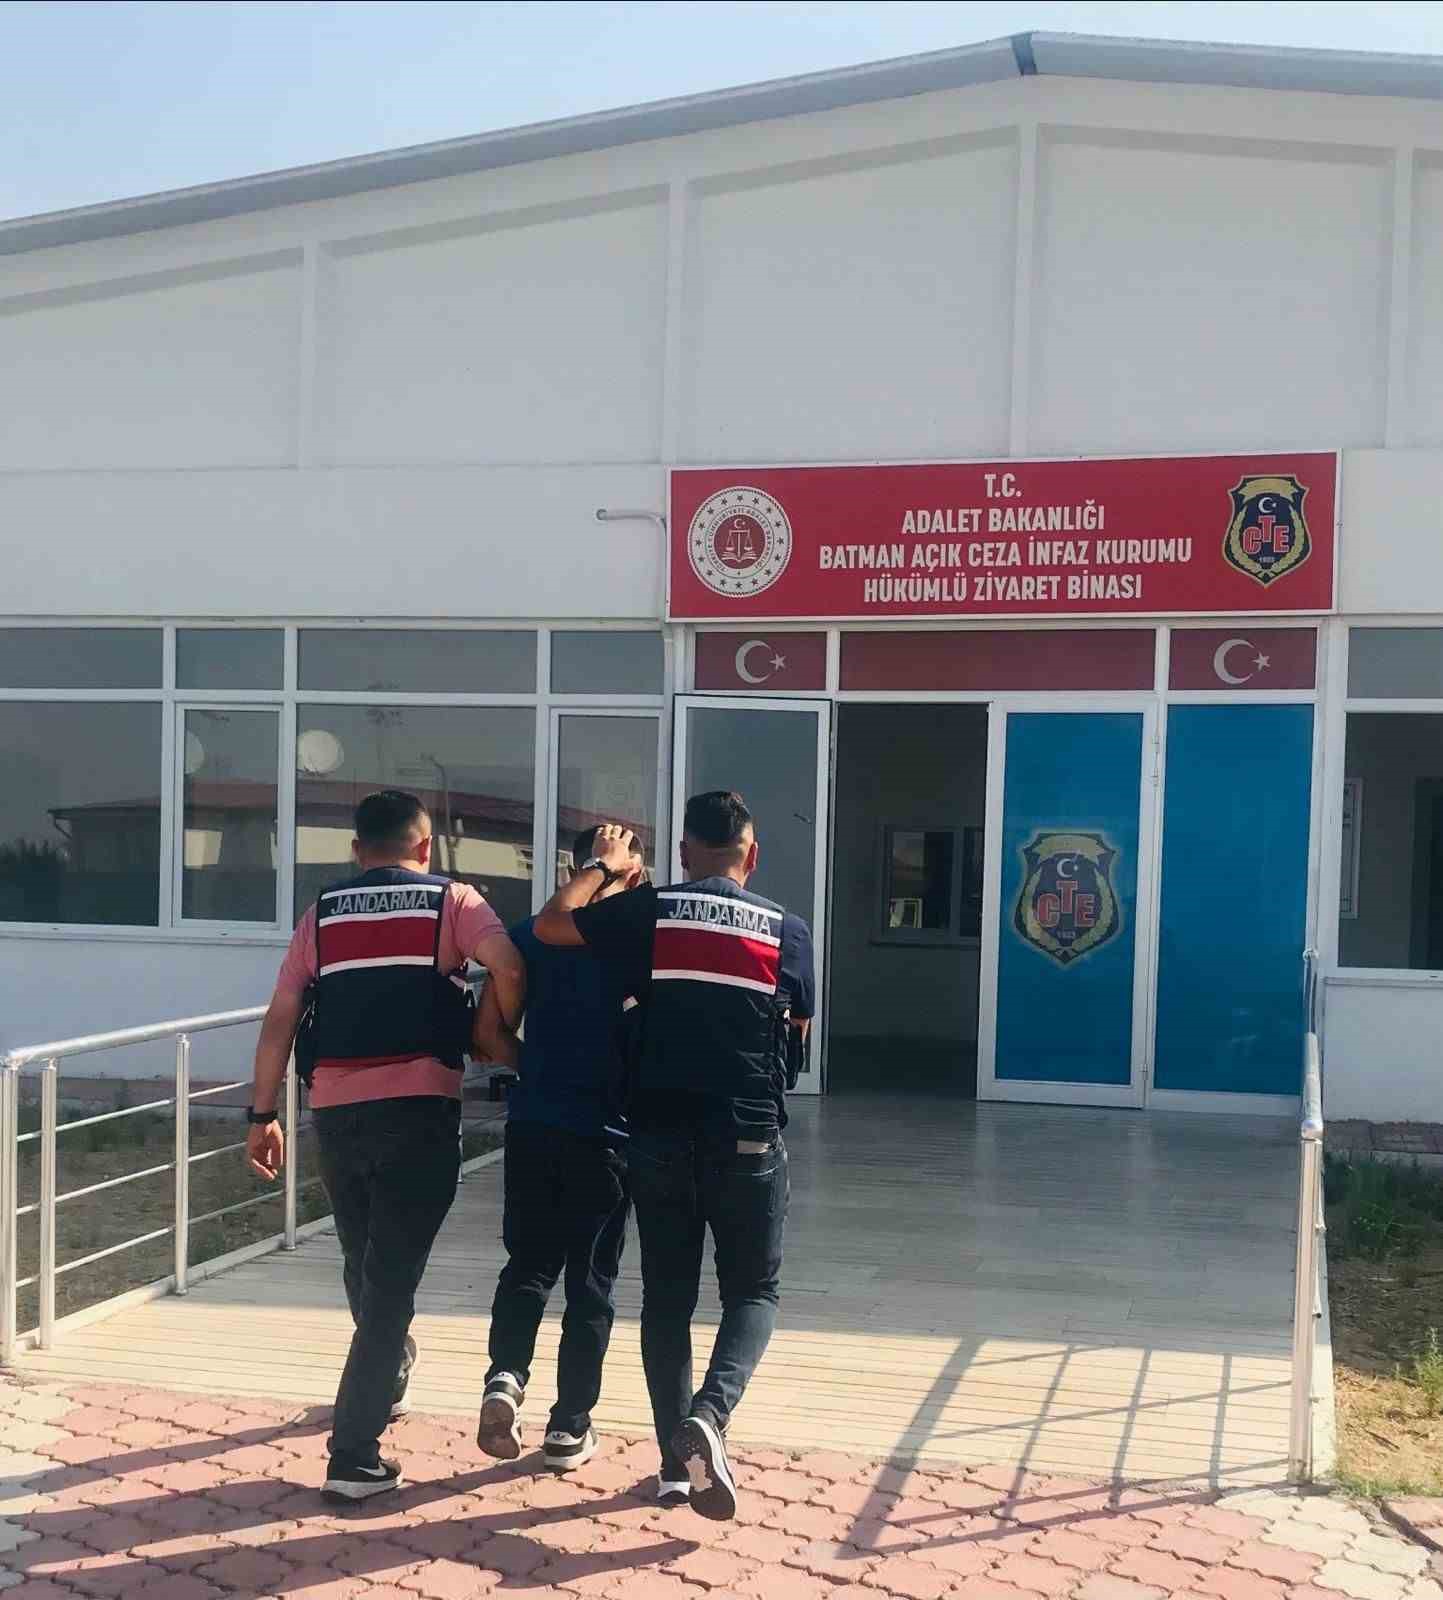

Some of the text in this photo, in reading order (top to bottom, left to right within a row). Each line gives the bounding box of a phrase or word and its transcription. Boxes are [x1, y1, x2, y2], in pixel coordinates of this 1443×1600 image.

[985, 473, 1022, 498] T.C.
[902, 499, 1105, 534] ADALET BAKANLIĞI
[819, 535, 1192, 573] BATMAN AÇIK CEZA İNFAZ KURUMU
[863, 569, 1142, 603] HÜKÜMLÜ ZİYARET BİNASI
[330, 891, 430, 915] JANDARMA
[668, 898, 771, 936] JANDARMA
